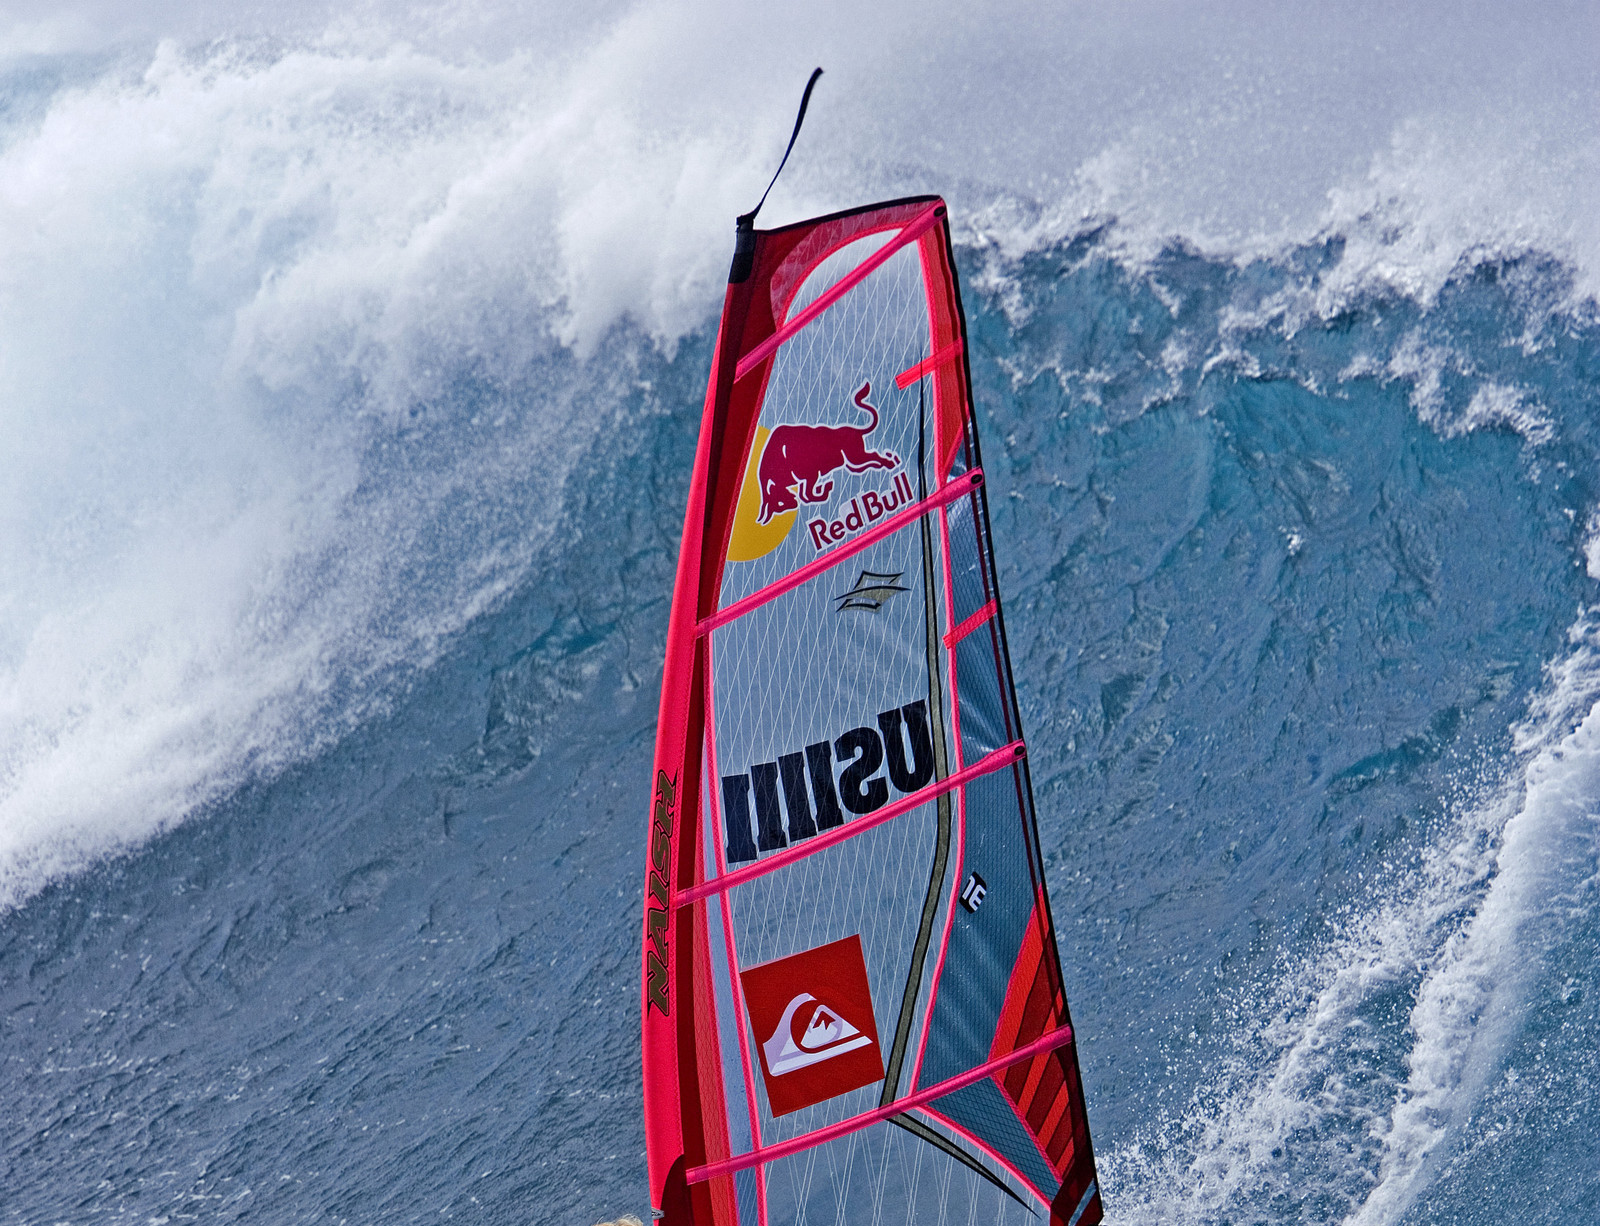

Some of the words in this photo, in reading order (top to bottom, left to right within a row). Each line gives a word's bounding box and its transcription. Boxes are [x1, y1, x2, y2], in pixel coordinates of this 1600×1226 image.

[808, 498, 864, 551] Red
[861, 471, 914, 523] Bull
[647, 768, 678, 1020] NAISH
